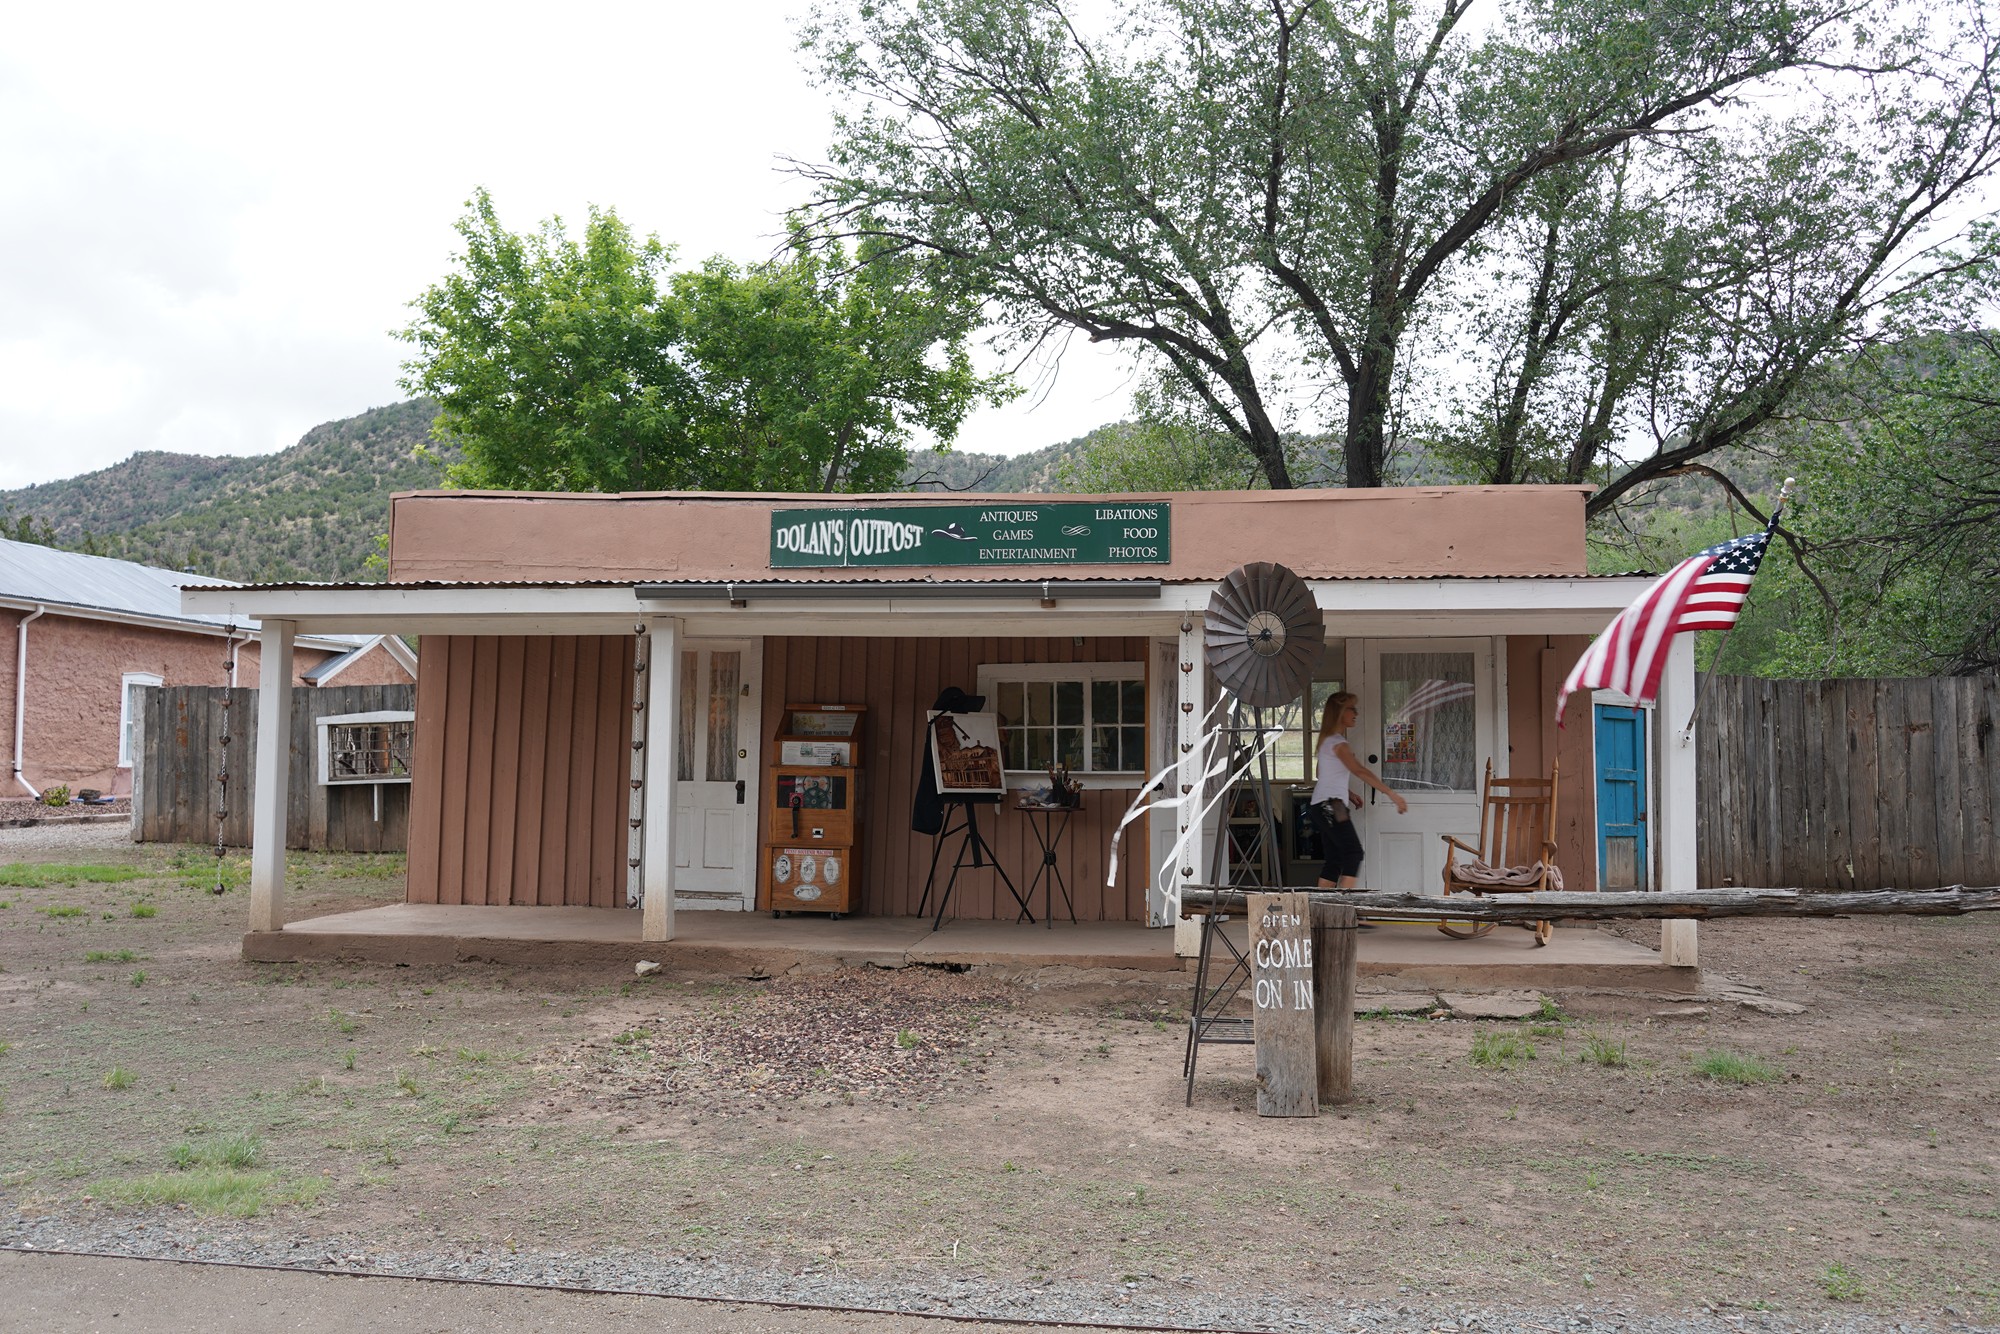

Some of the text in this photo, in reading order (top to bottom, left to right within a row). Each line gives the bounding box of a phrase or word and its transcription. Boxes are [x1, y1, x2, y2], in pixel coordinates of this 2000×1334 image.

[979, 510, 1038, 523] ANTIQUES
[1095, 509, 1158, 520] LIBATIONS
[776, 518, 924, 557] DOLAN'S OUTPOST
[992, 529, 1034, 541] GAMES
[1122, 527, 1158, 539] FOOD
[979, 547, 1078, 560] ENTERTAINMENT
[1108, 546, 1158, 558] PHOTOS
[1262, 914, 1301, 928] OPEN
[1256, 938, 1313, 969] COME
[1256, 979, 1314, 1010] ON IN
